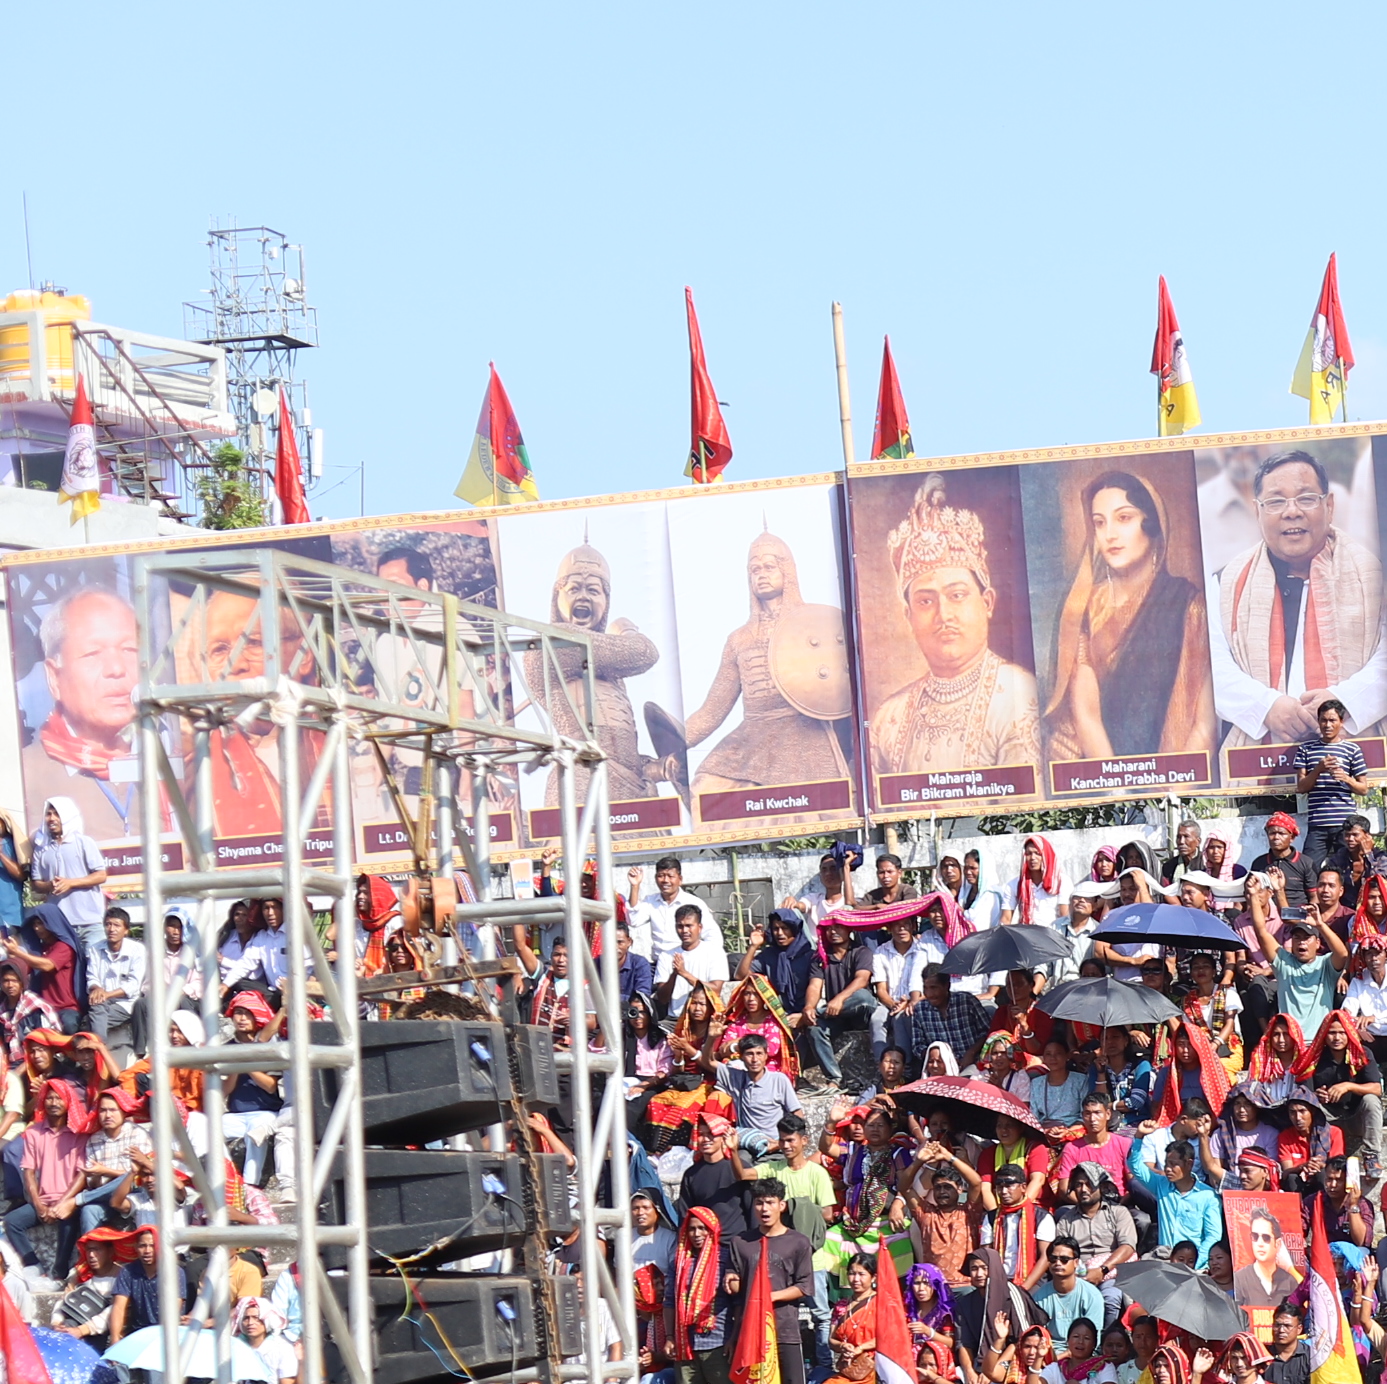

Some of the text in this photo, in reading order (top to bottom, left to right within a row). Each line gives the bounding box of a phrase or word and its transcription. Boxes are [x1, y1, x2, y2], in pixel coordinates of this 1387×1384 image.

[1101, 760, 1156, 774] Maharani
[1259, 753, 1290, 769] Lt. P.
[928, 771, 983, 786] Maharaja
[1071, 769, 1195, 790] Kanchan Prabha Devi
[900, 783, 1015, 802] Bir Bikram Manikya
[745, 794, 809, 812] Rai Kwchak
[378, 832, 394, 844] Lt.
[218, 843, 262, 860] Shyama
